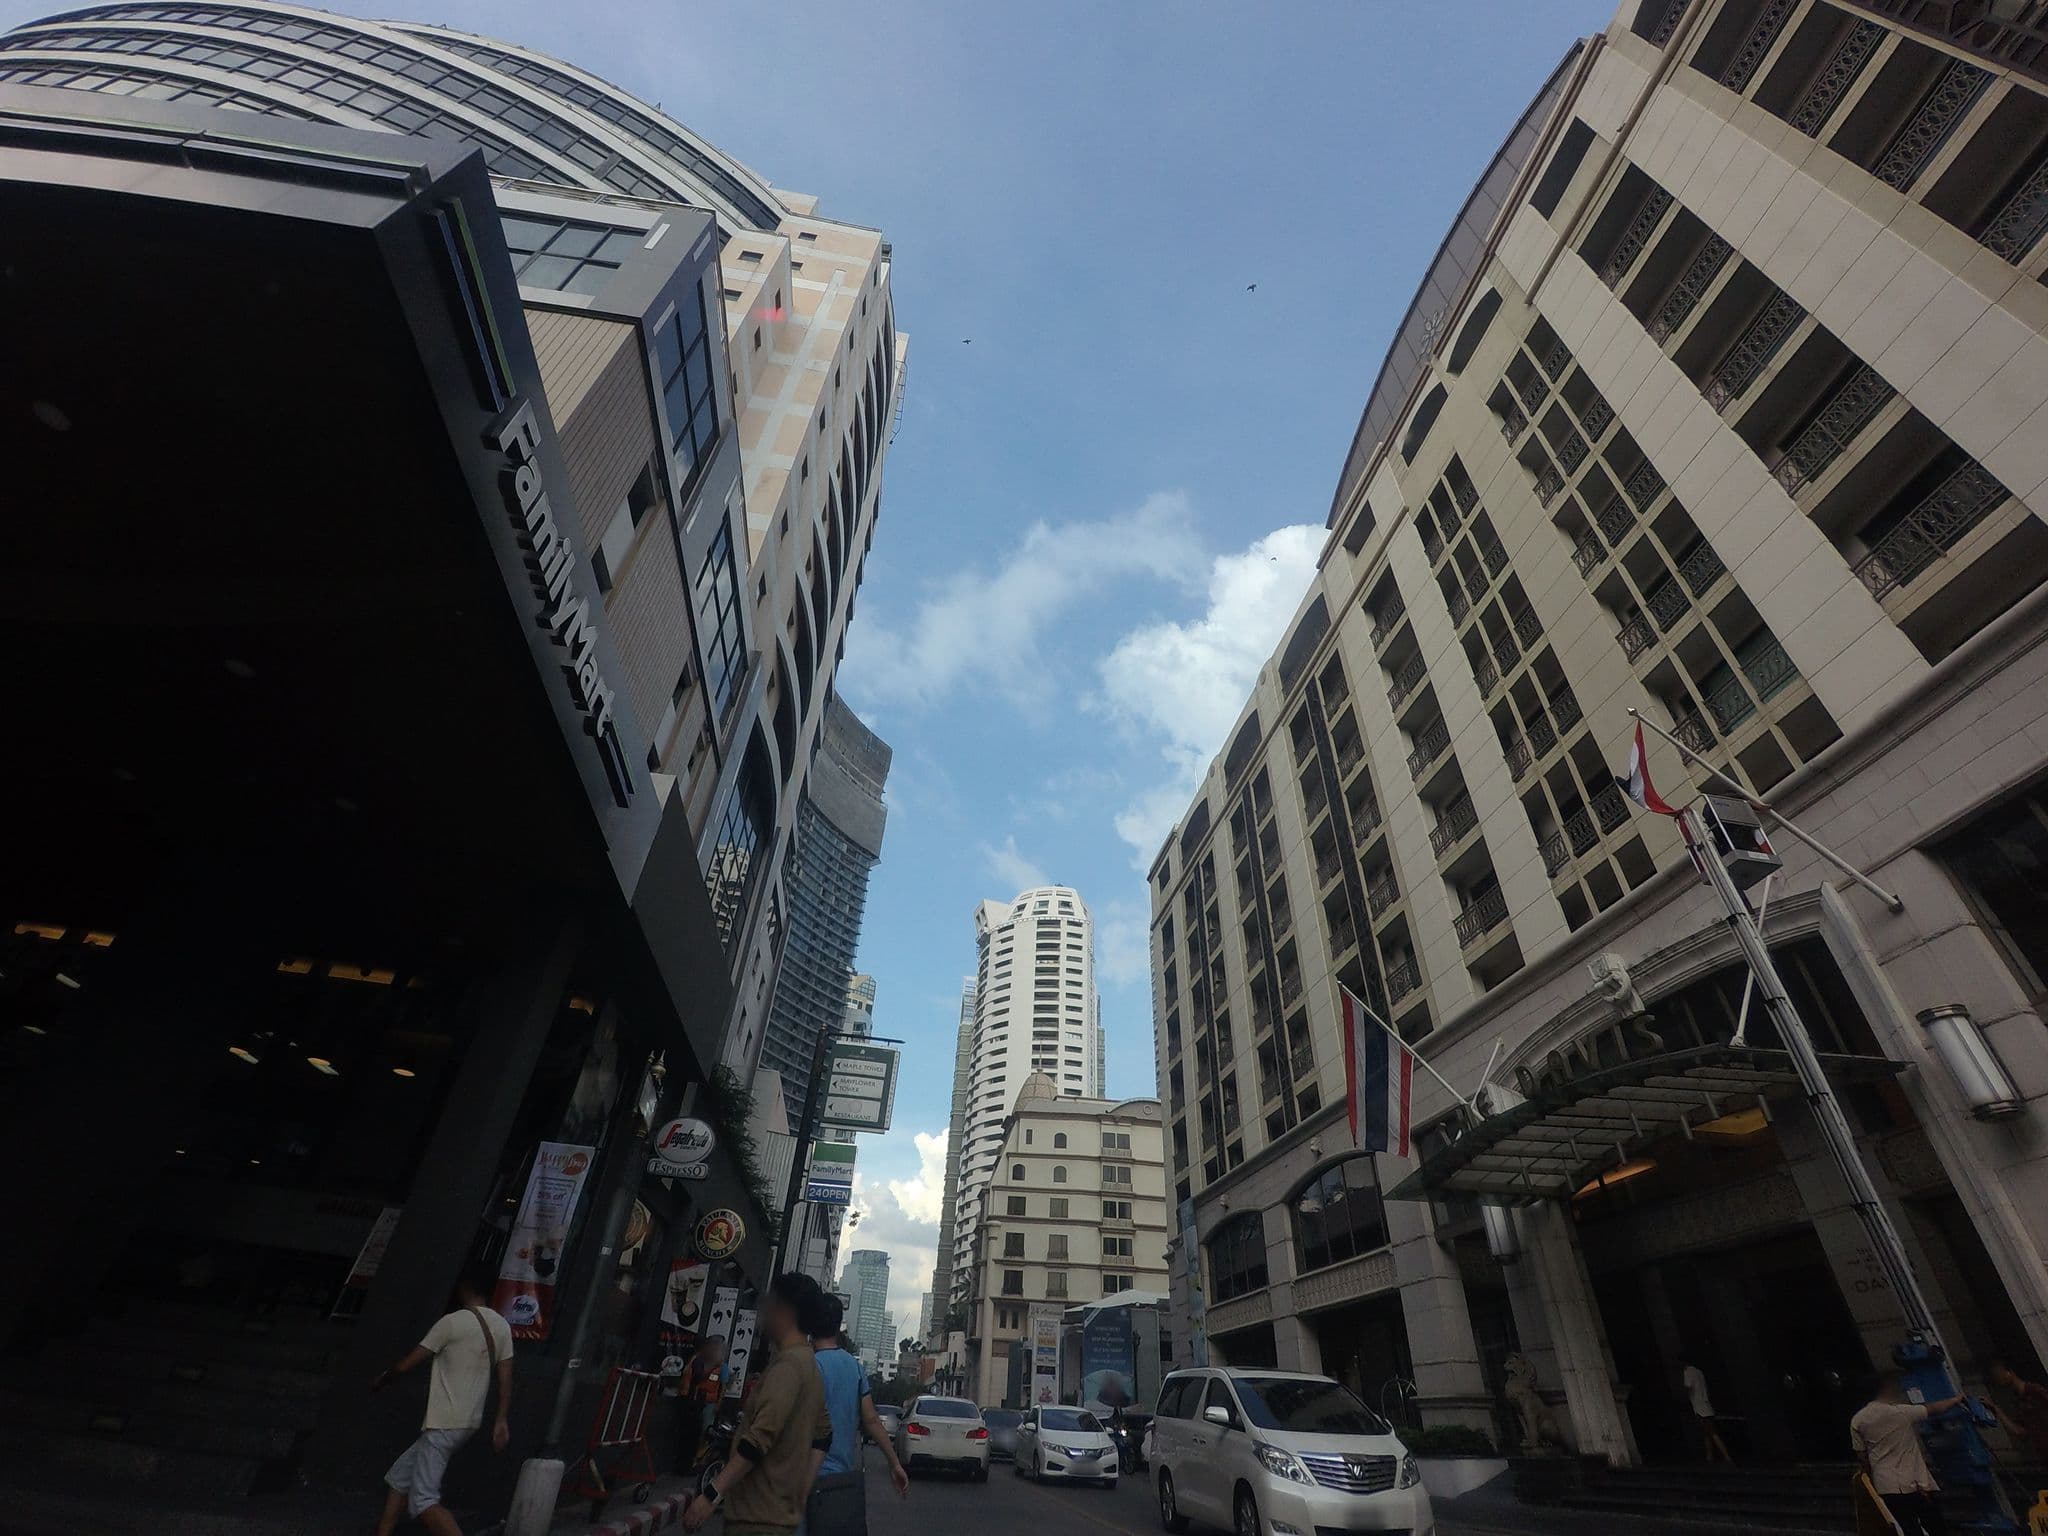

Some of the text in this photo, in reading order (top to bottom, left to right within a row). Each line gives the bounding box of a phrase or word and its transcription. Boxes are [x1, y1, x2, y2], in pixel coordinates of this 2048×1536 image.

[494, 398, 617, 738] FamilyMart
[864, 1065, 884, 1073] TOWER
[654, 1162, 702, 1176] ESPRESSO
[812, 1164, 853, 1176] FamilyMart
